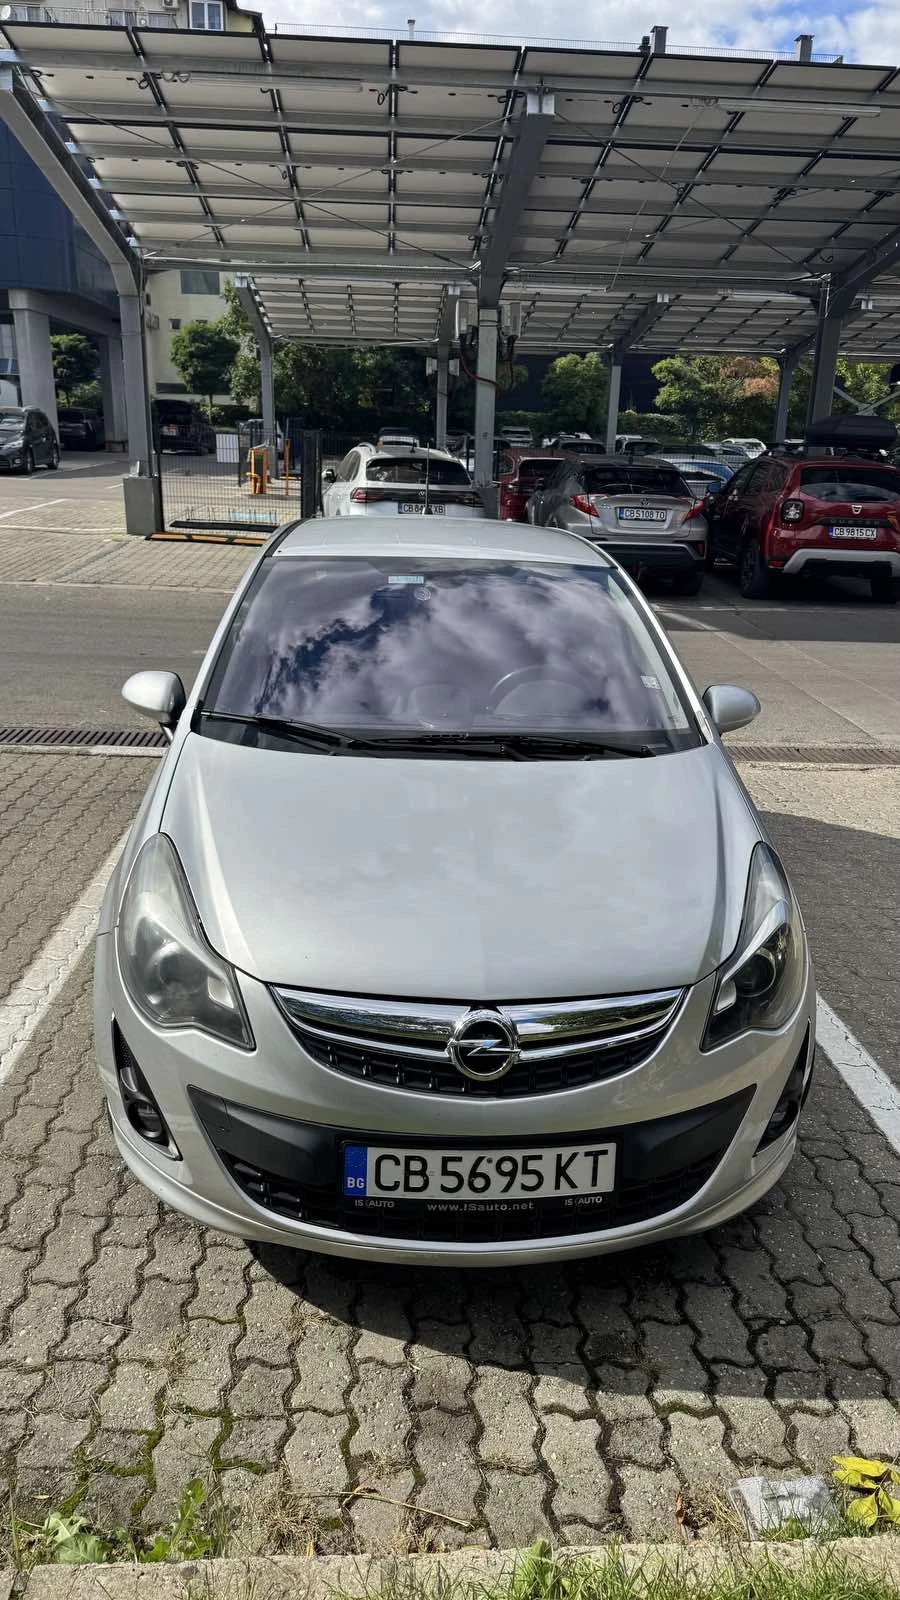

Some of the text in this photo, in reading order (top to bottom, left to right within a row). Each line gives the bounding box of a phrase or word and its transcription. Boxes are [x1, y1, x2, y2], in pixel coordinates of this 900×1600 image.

[403, 504, 414, 513] CB
[625, 509, 635, 518] CB
[635, 509, 654, 519] 5108
[835, 528, 875, 537] CB 9815 CX
[374, 1149, 609, 1194] CB 5695 KT
[346, 1177, 365, 1189] BG
